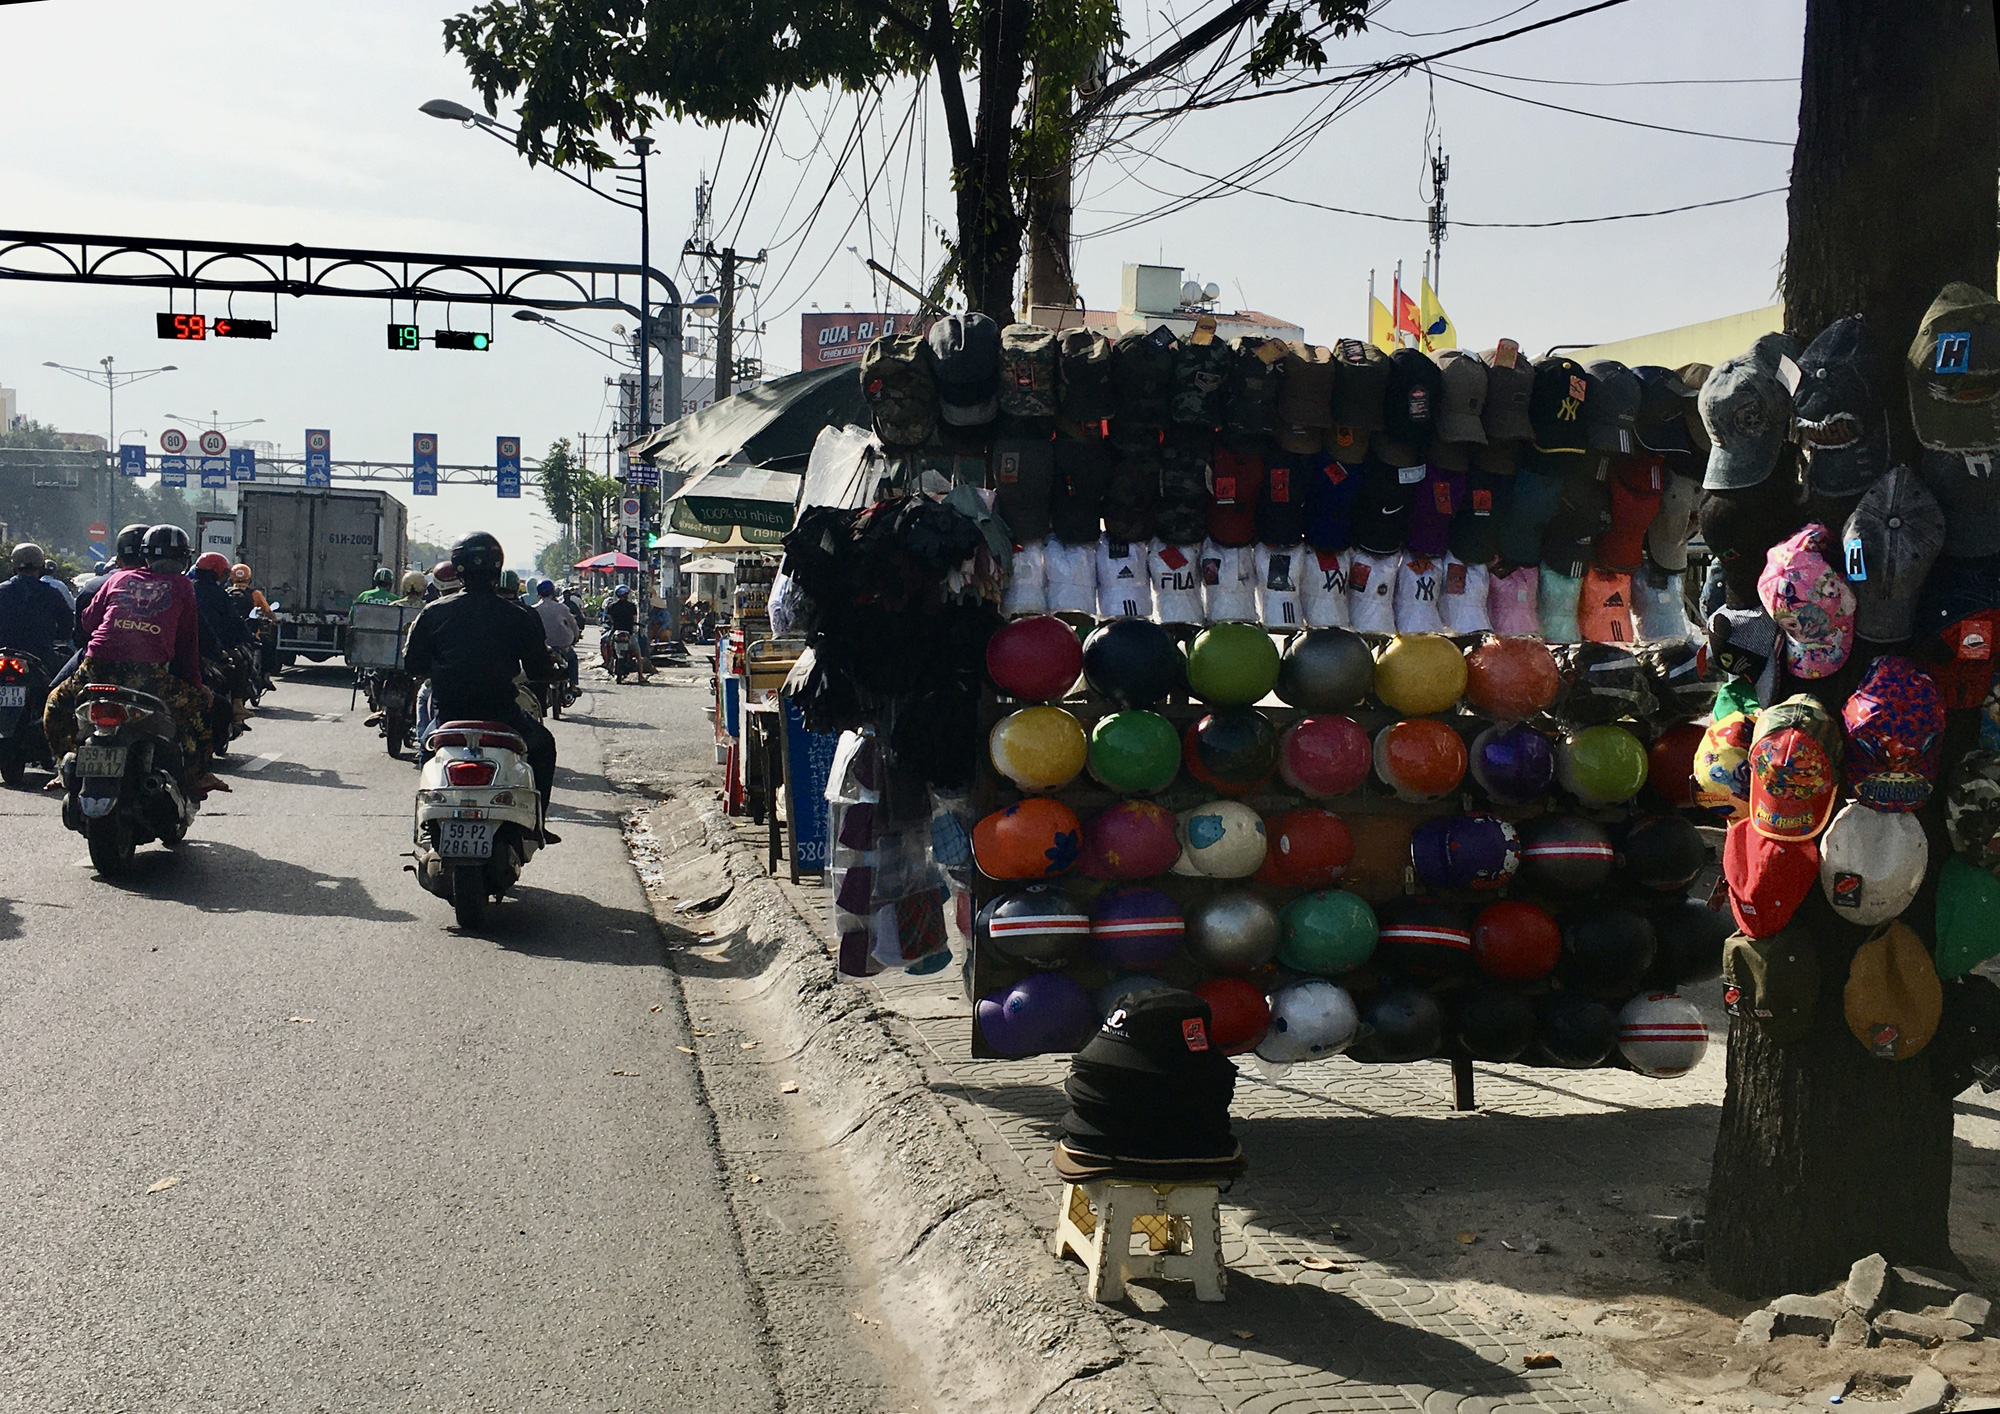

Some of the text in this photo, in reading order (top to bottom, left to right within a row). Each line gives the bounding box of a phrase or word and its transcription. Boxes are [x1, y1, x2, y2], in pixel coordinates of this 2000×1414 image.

[174, 315, 203, 339] 59
[399, 327, 417, 348] 19
[167, 435, 180, 447] 80
[207, 437, 219, 449] 60
[313, 437, 323, 446] 60
[420, 440, 430, 450] 50
[504, 444, 513, 453] 50
[1161, 572, 1195, 591] FILA
[114, 619, 161, 635] KENZO
[450, 824, 486, 840] 59-P2
